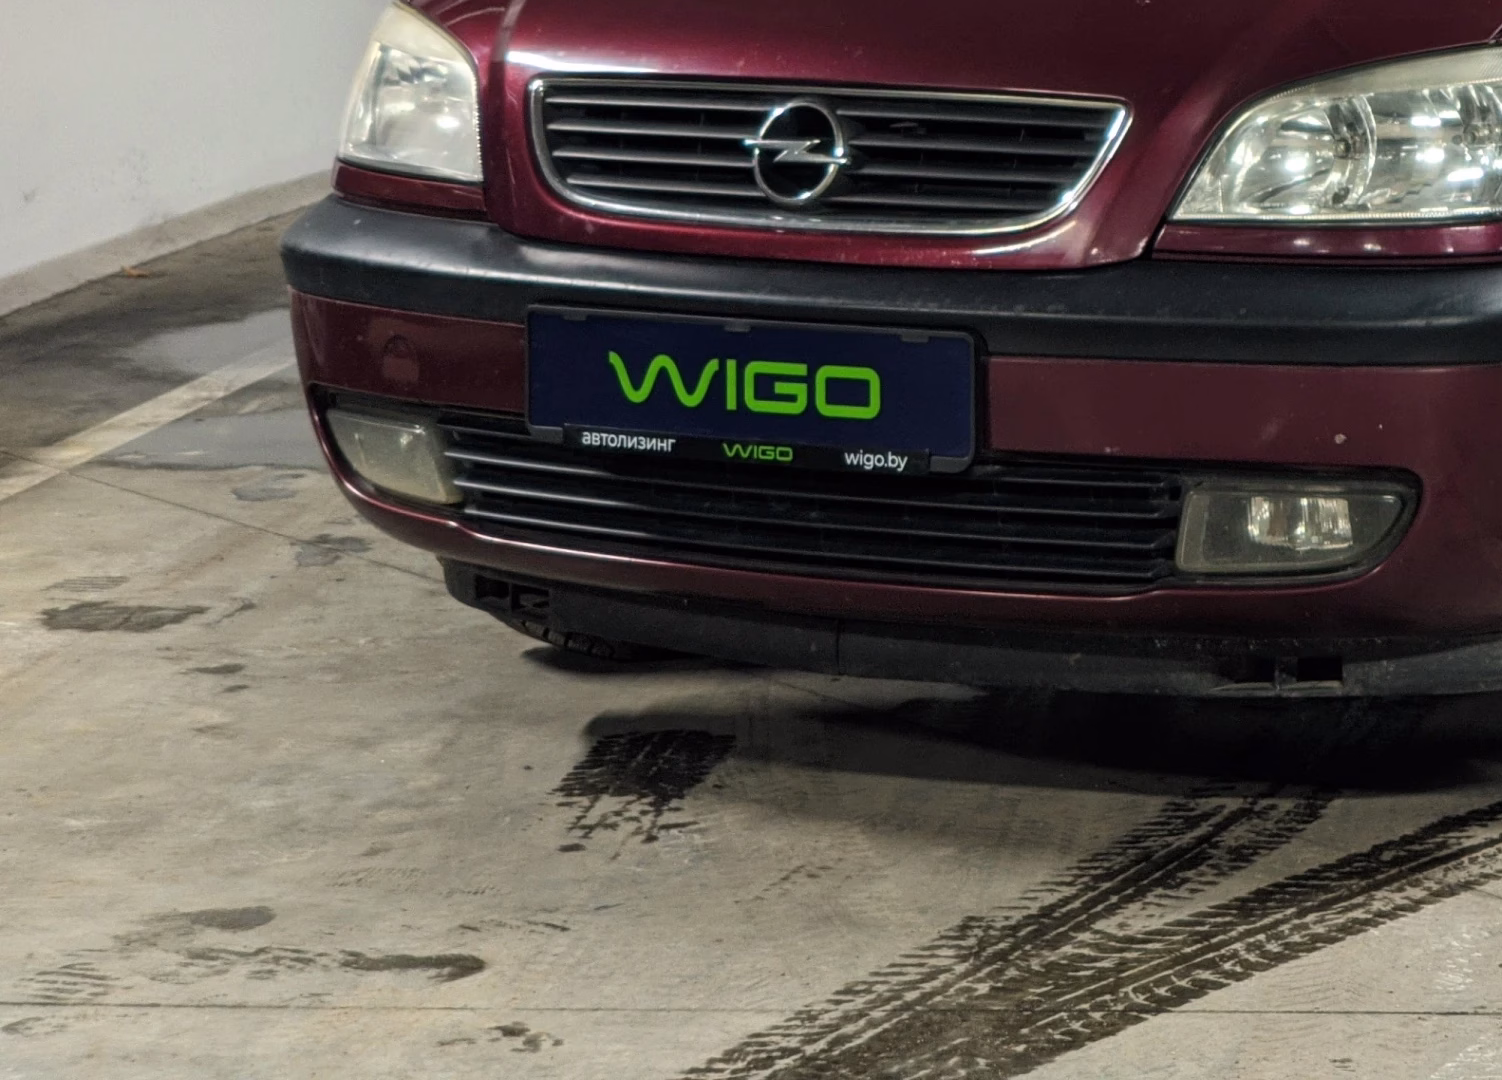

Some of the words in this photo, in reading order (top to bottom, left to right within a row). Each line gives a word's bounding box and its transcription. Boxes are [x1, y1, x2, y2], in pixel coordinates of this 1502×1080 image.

[608, 350, 881, 420] WIGO
[582, 430, 677, 453] автолизинг
[722, 442, 794, 462] WIGO
[844, 449, 908, 472] wigo.by
